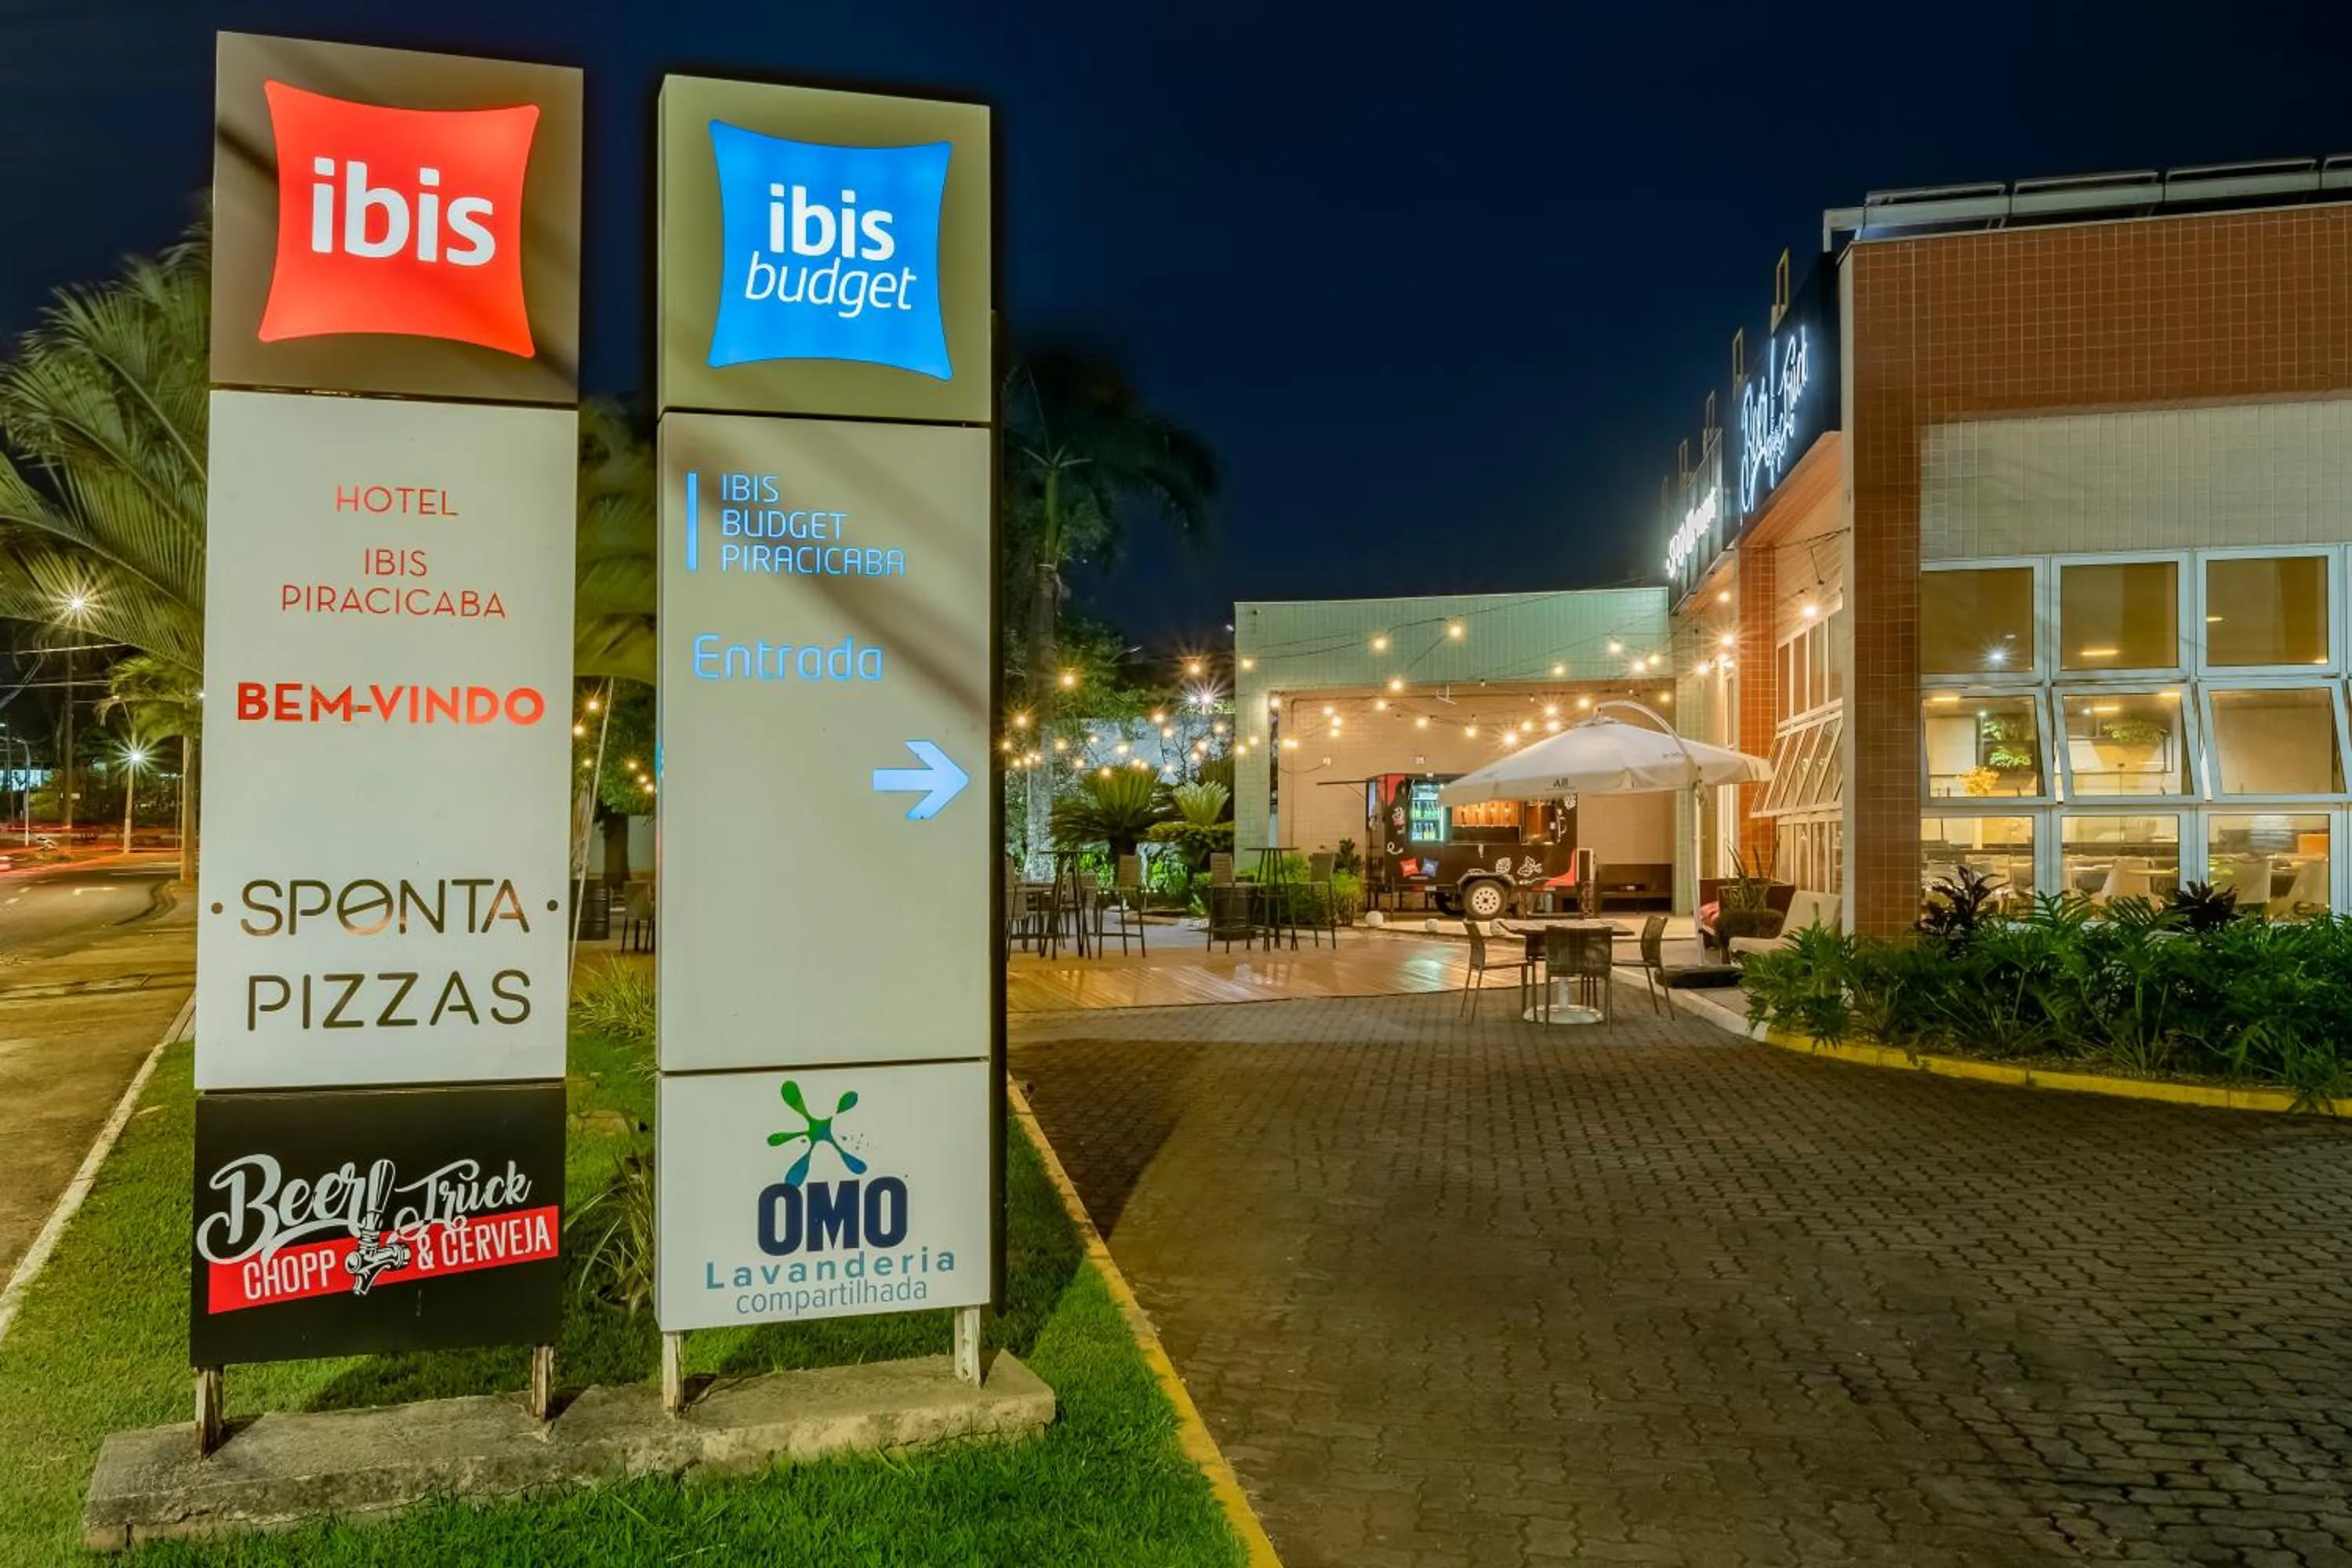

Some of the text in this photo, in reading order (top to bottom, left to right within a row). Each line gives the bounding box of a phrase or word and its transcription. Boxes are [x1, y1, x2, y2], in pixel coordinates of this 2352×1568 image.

[311, 157, 495, 267] ibis
[769, 183, 895, 261] ibis
[744, 250, 916, 318] budget
[336, 485, 459, 517] HOTEL
[720, 473, 779, 503] IBIS
[720, 508, 847, 540] BUDGET
[364, 549, 428, 578] IBIS
[720, 544, 906, 578] PIRACICABA
[281, 584, 506, 618] PIRACICABA
[692, 633, 884, 682] Entrada
[238, 682, 546, 727] BEM-VINDO
[240, 879, 531, 936] SPONTA
[247, 970, 532, 1032] PIZZAS
[196, 1153, 532, 1265] Beer Truck
[758, 1176, 908, 1256] OMO
[242, 1214, 552, 1301] CHOPP & CERVEJA
[706, 1247, 955, 1290] Lavanderia
[735, 1276, 928, 1316] compartilhada
